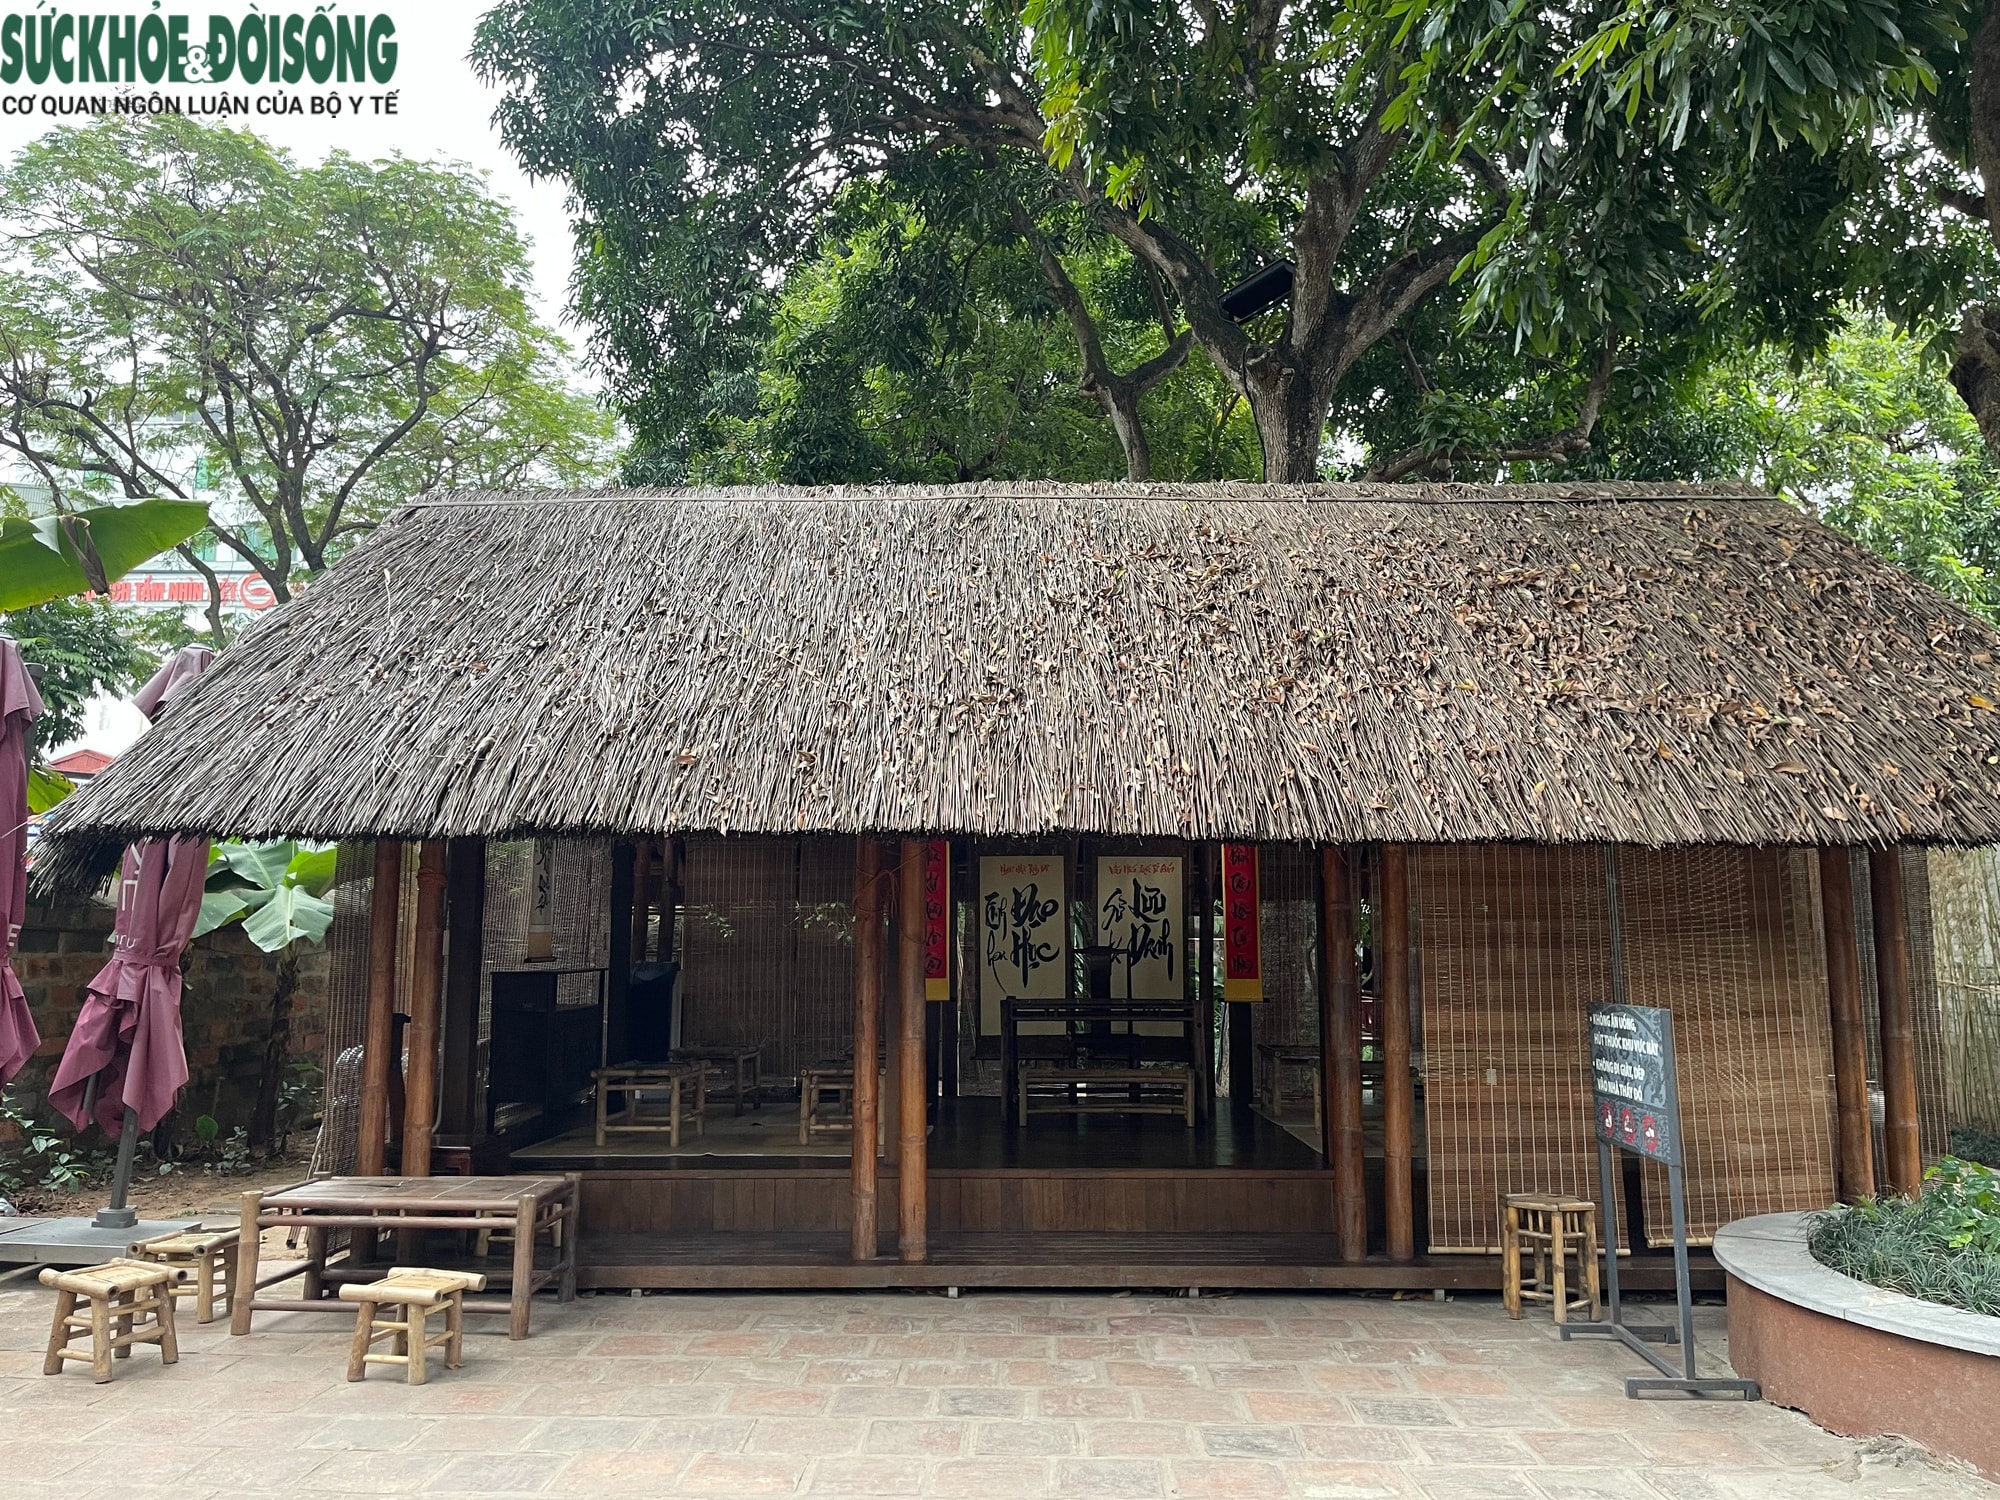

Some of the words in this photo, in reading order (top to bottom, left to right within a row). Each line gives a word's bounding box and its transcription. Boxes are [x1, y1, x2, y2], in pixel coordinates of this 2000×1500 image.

[169, 577, 204, 602] NHÌN
[1593, 1012, 1610, 1027] KHÔNG
[1594, 1031, 1604, 1046] HÚT
[1604, 1032, 1622, 1050] THUỐC
[1622, 1037, 1634, 1052] KHU
[1634, 1038, 1646, 1058] VỰC
[1596, 1057, 1613, 1073] KHÔNG
[1597, 1077, 1608, 1092] VÀO
[1608, 1080, 1619, 1096] NHÀ
